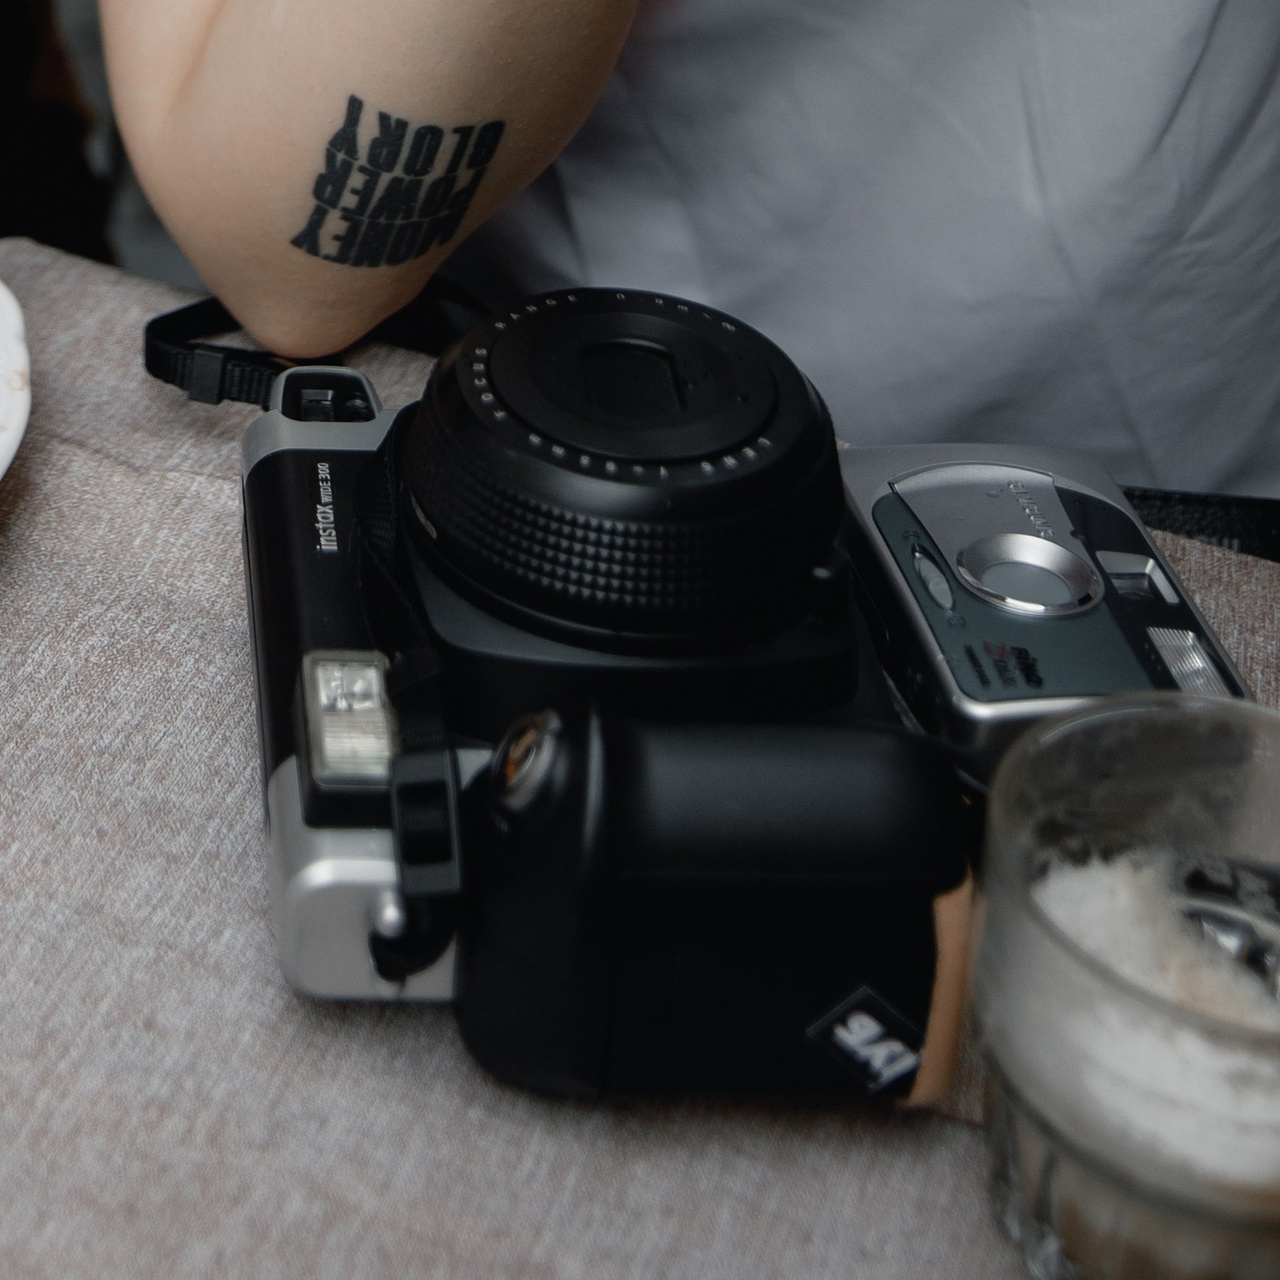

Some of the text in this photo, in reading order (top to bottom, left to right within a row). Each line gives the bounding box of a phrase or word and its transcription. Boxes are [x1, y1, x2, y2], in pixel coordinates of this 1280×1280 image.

[328, 94, 505, 176] GLORY
[313, 147, 486, 219] POWER
[290, 204, 467, 267] MONEY
[472, 347, 506, 419] FOCUS
[494, 294, 578, 330] RANGE
[702, 436, 773, 474] LENS
[315, 462, 338, 551] instax WIDE 300
